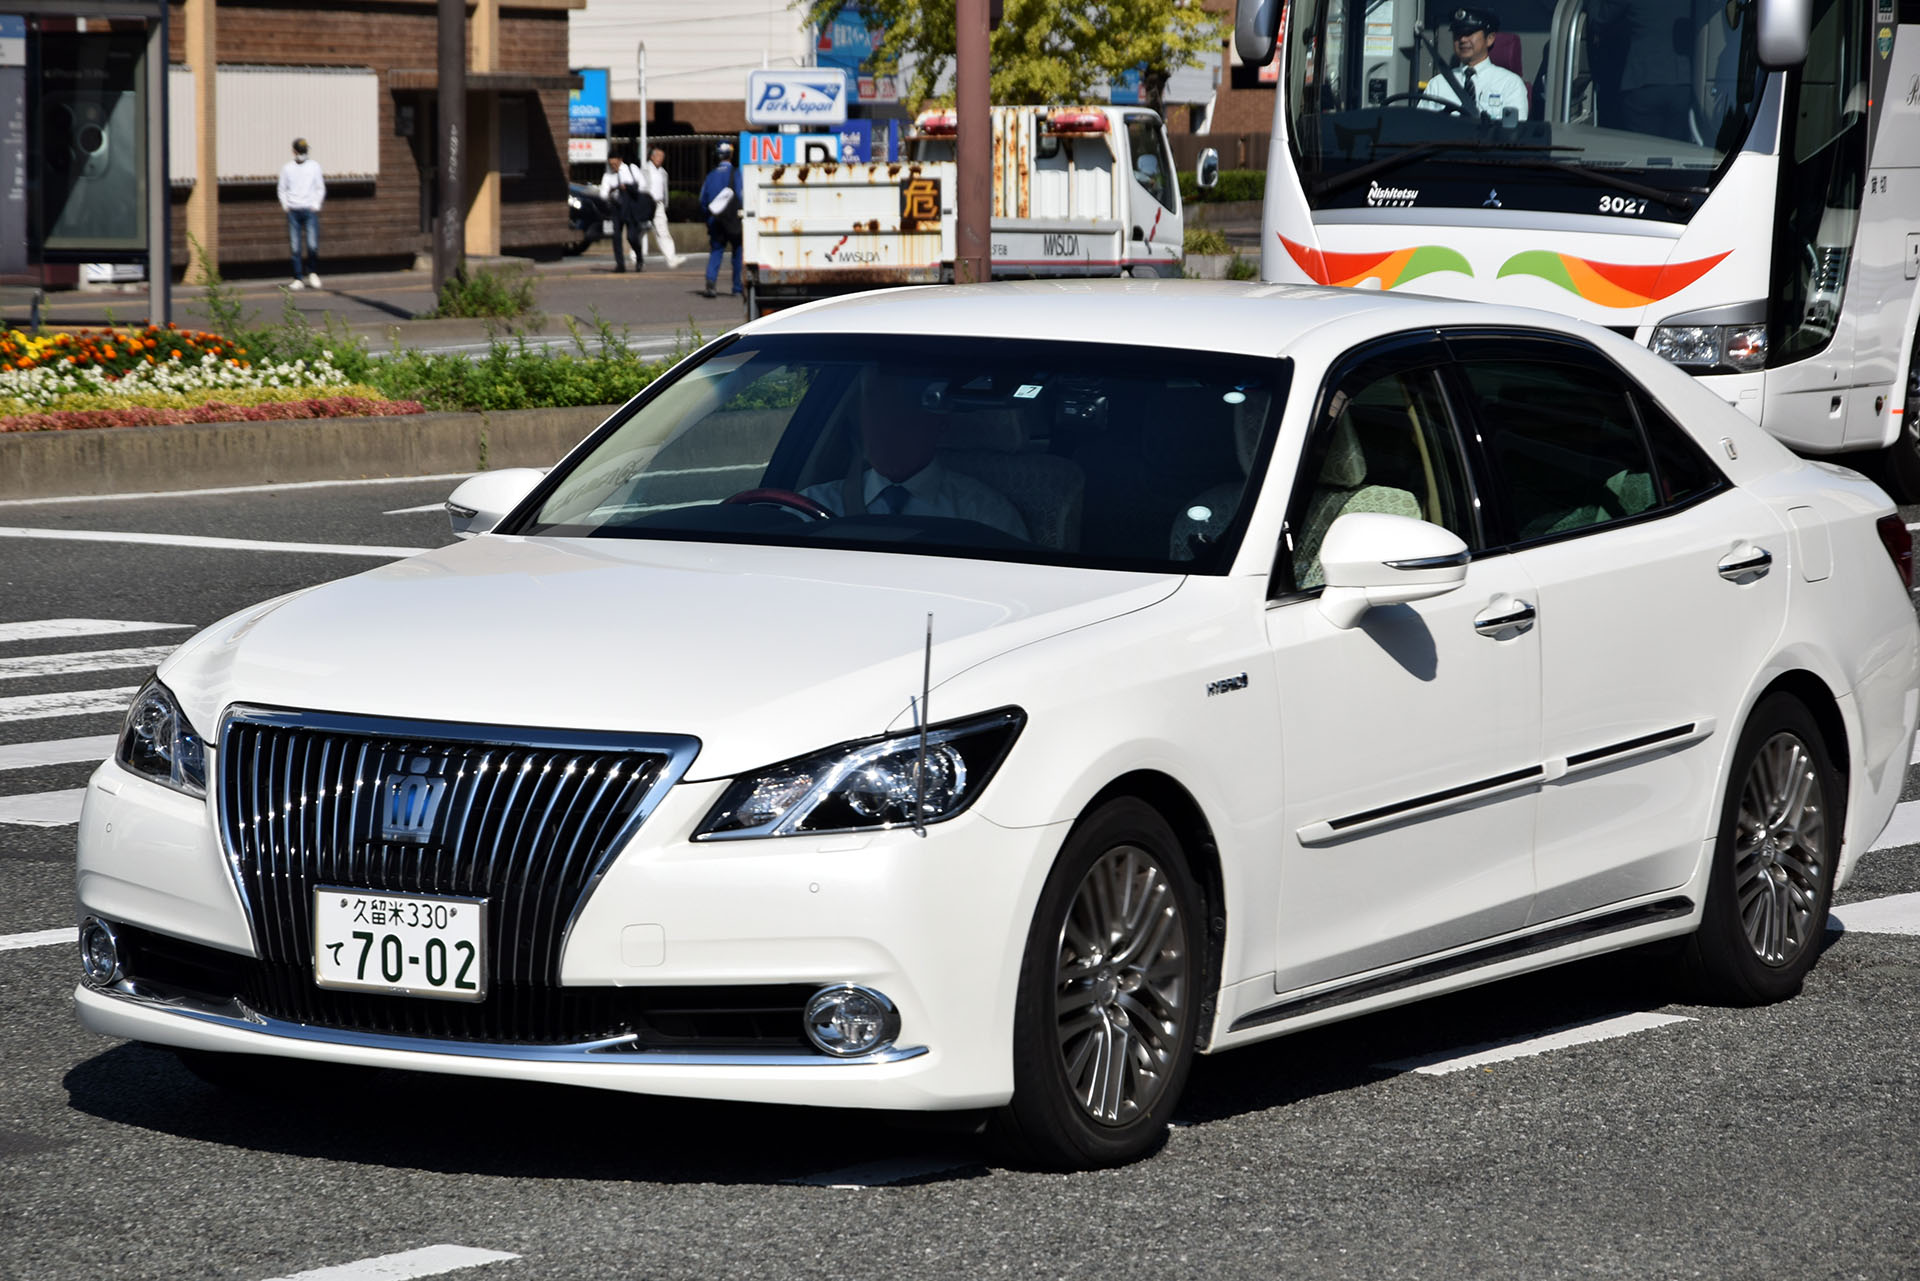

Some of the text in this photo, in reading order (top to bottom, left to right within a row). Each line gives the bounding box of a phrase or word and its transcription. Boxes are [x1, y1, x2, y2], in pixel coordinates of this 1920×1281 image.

[756, 82, 833, 114] Park Japan
[750, 136, 782, 162] IN
[903, 179, 938, 218] 危
[1367, 180, 1419, 203] Nishitetsu
[1376, 199, 1414, 208] Group
[1599, 195, 1648, 215] 3027
[839, 251, 880, 263] MASUDA
[1043, 233, 1080, 257] MASUDA
[353, 897, 448, 930] 久留米330
[326, 931, 476, 990] て 70-02
